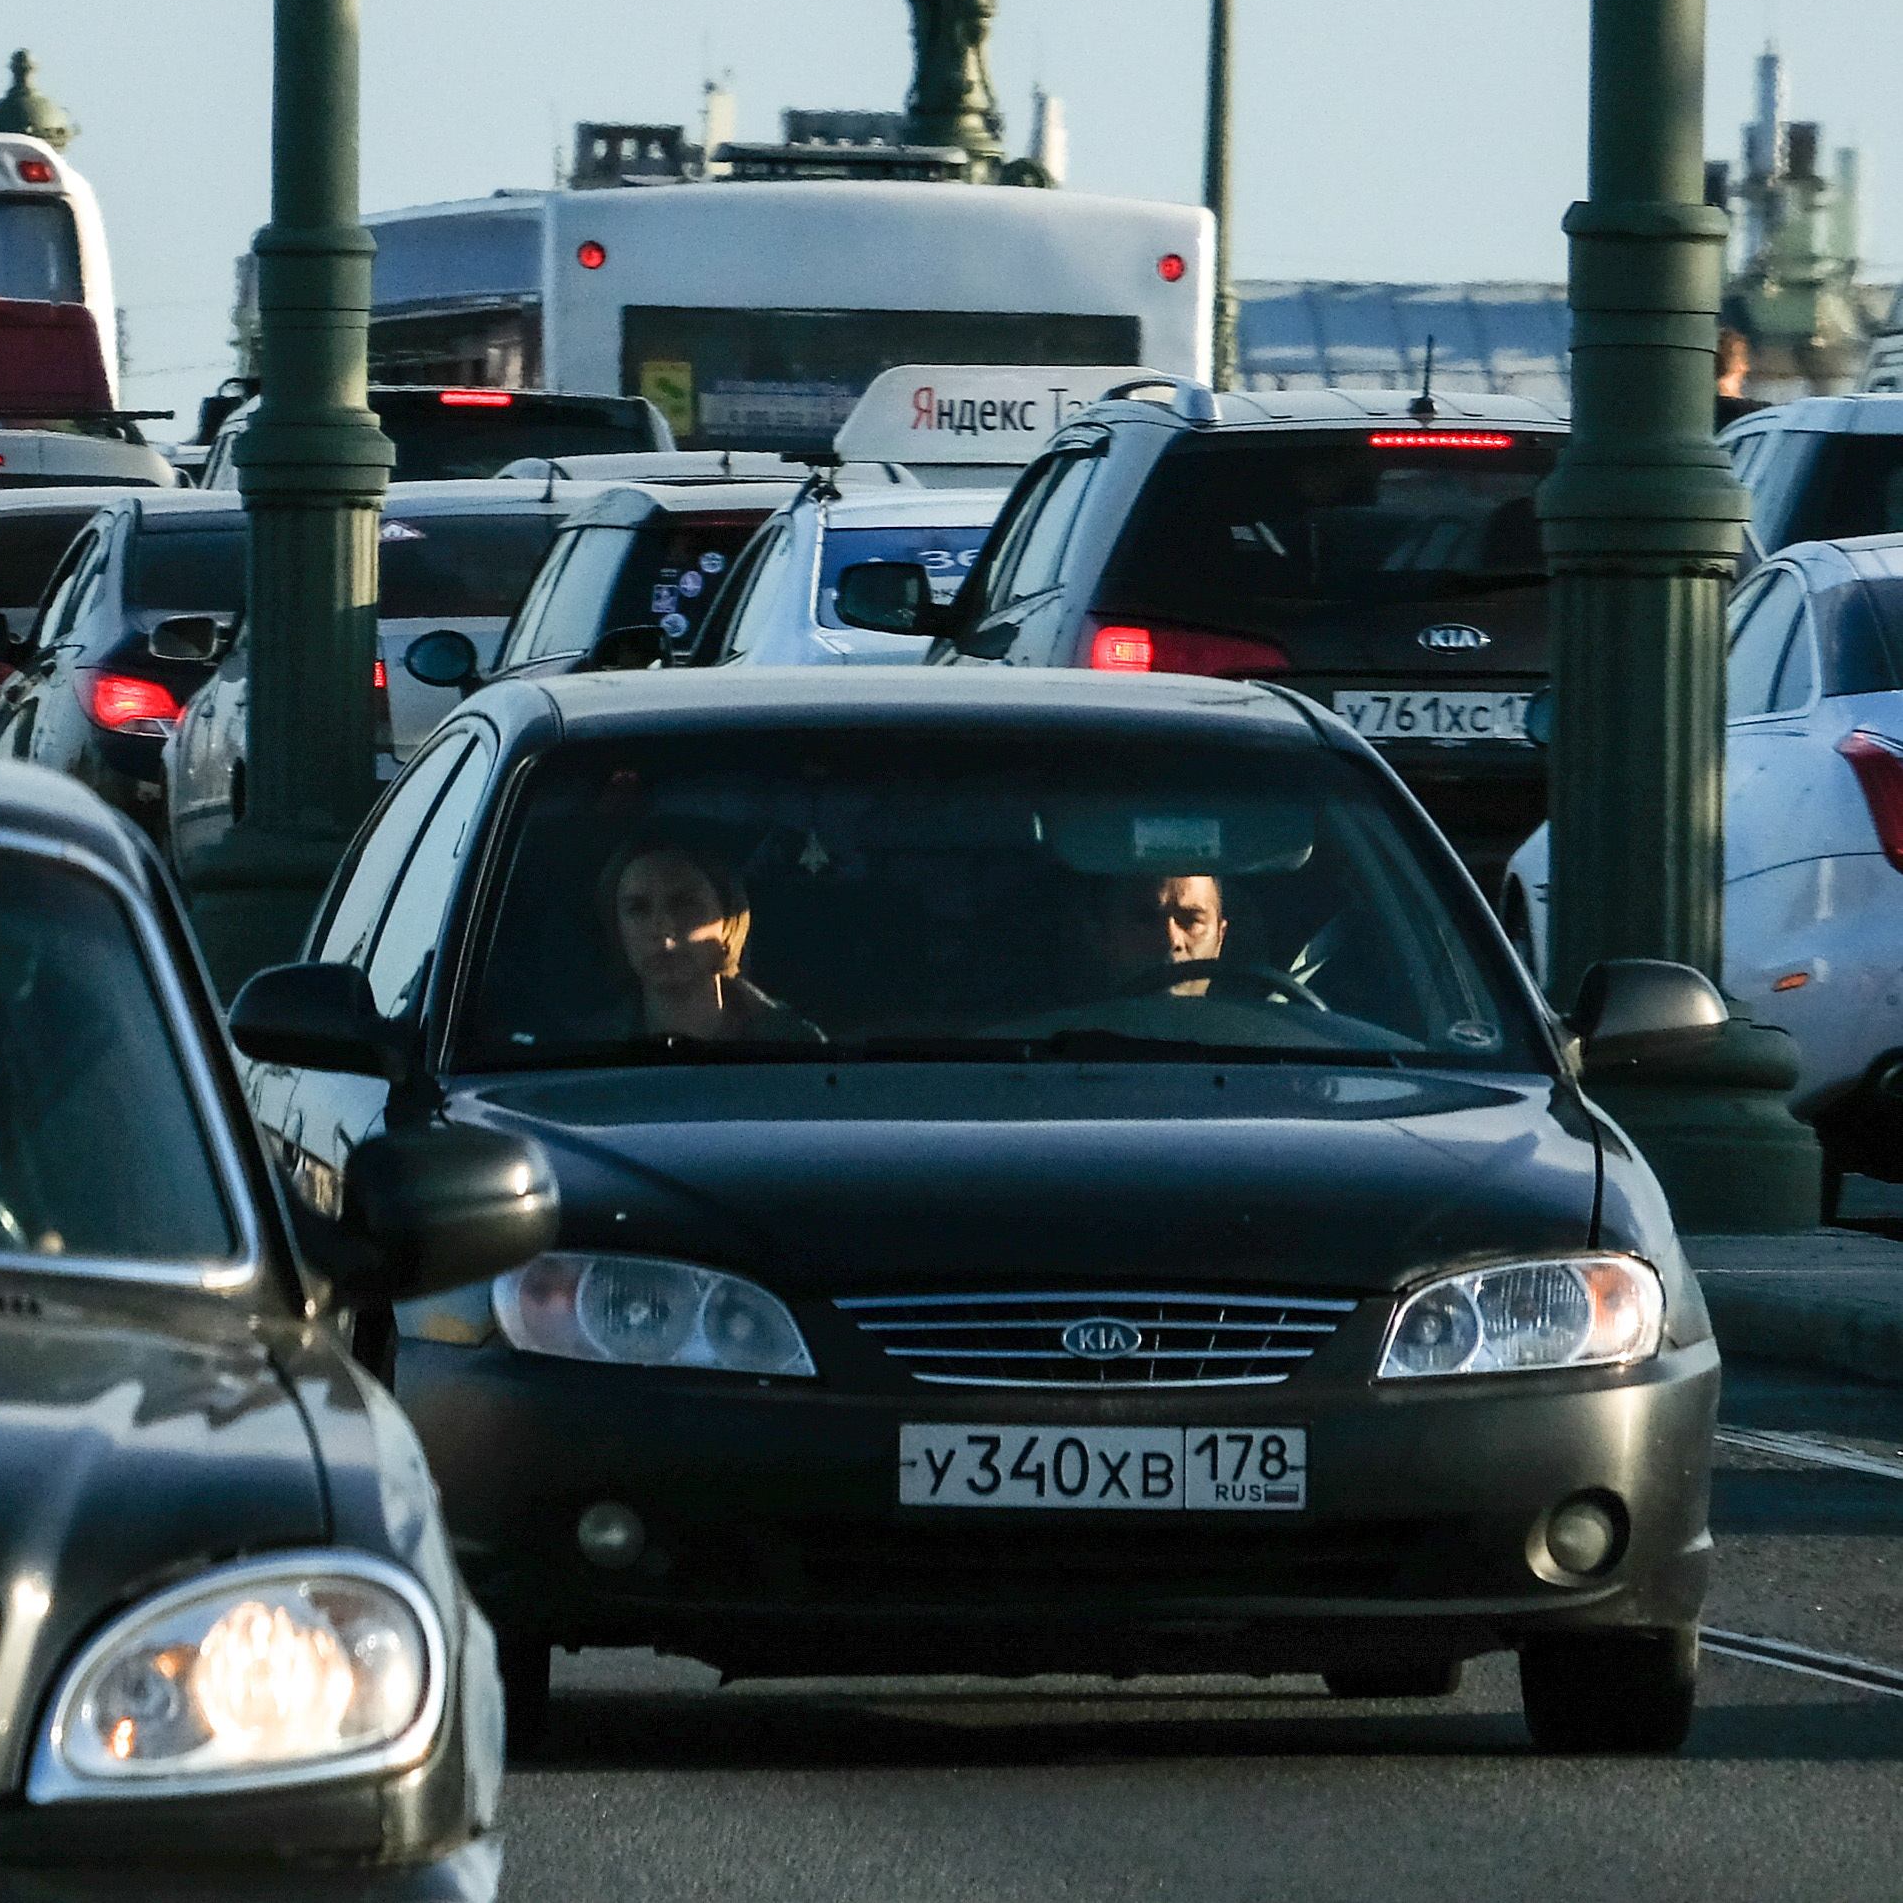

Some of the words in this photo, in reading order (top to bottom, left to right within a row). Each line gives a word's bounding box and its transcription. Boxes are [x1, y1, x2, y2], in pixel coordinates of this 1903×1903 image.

[911, 387, 1037, 435] Яндекс
[1430, 629, 1478, 647] KIA
[1078, 1328, 1127, 1351] KIA
[924, 1434, 1174, 1499] У340ХВ
[1193, 1433, 1289, 1481] 178
[1215, 1485, 1262, 1502] RUS
